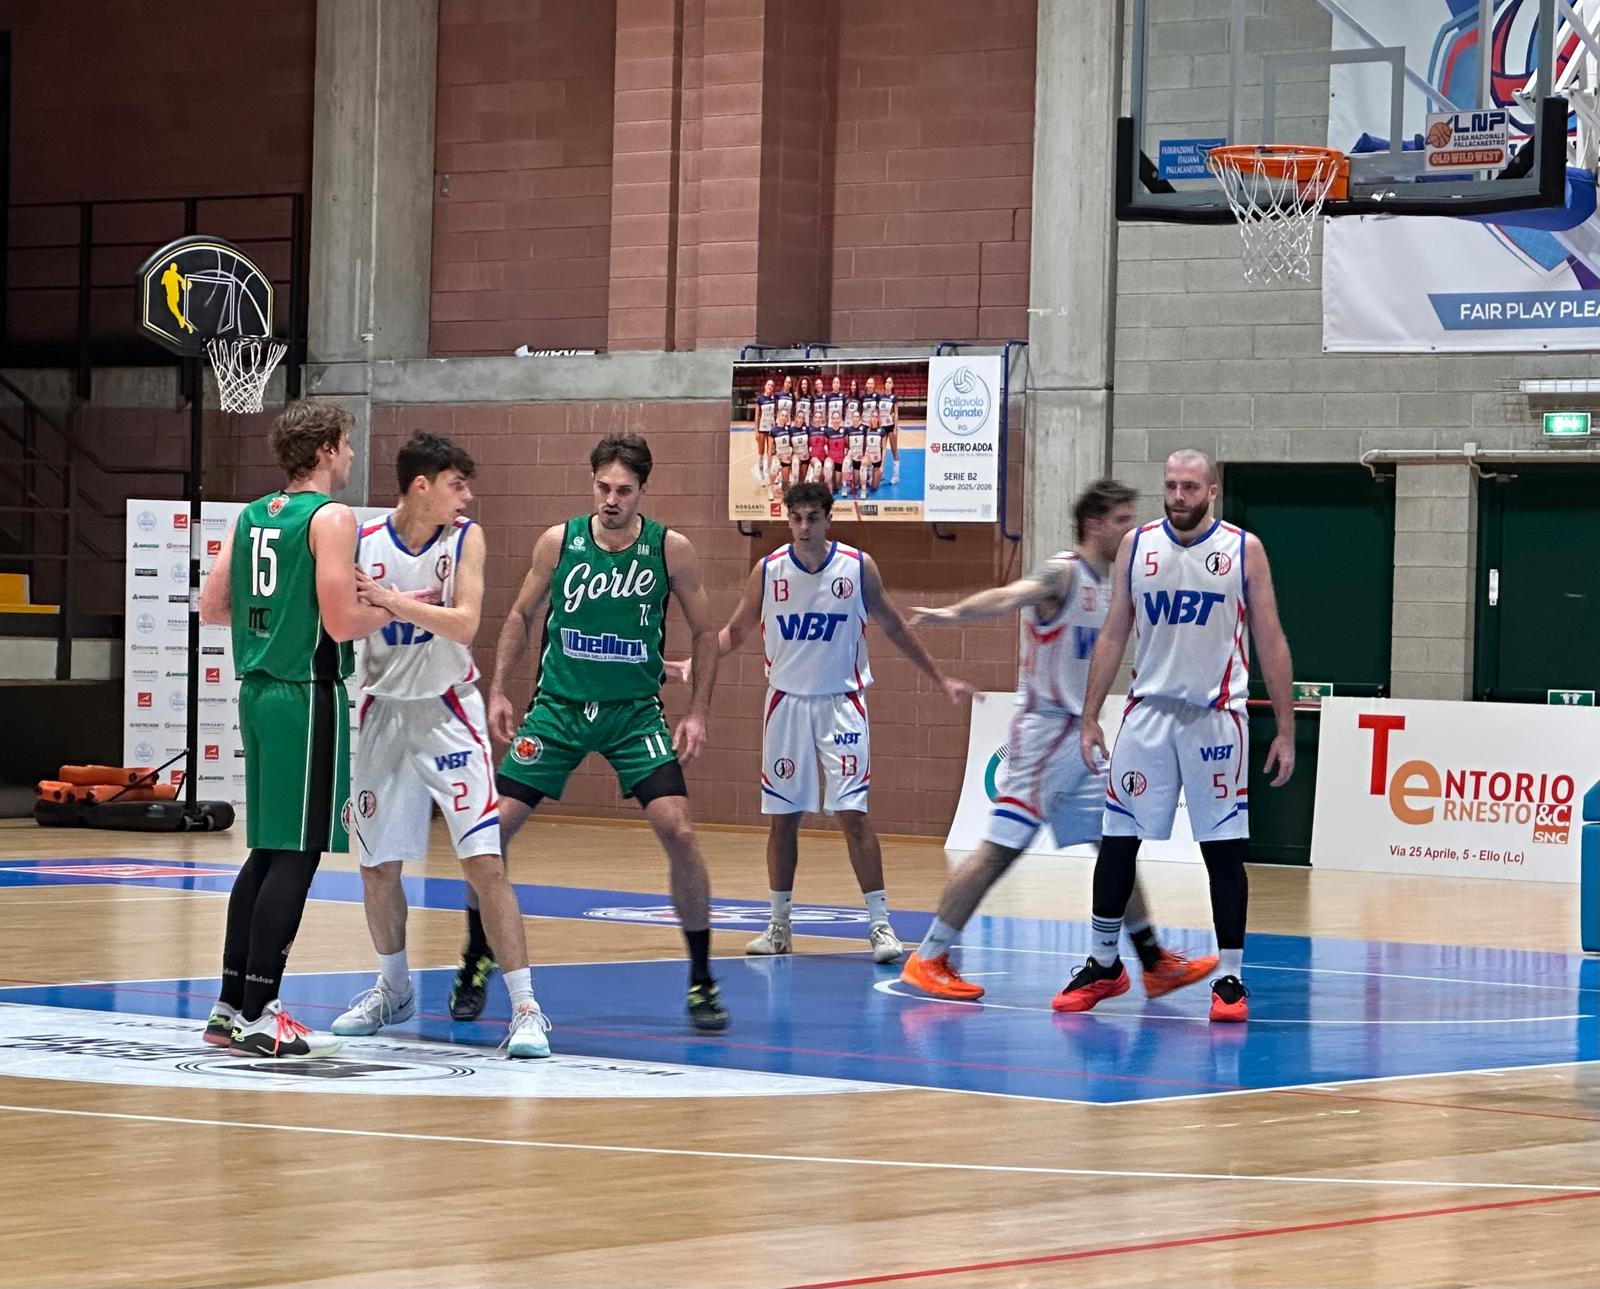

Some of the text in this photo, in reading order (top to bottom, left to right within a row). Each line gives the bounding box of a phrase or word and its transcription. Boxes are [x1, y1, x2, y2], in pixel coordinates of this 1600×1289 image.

[1453, 112, 1505, 133] LNP
[1453, 140, 1506, 148] PALLACANESTRO
[1470, 133, 1505, 141] NAZIONALE
[1161, 145, 1195, 155] FEDERAZIONE
[1431, 154, 1451, 164] OLD
[1451, 152, 1474, 163] WILD
[1475, 150, 1500, 161] WEST
[1177, 155, 1200, 164] ITALIANA
[1165, 165, 1205, 174] PALLACANESTRO
[1460, 303, 1503, 320] FAIR
[1506, 301, 1557, 318] PLAY
[944, 397, 984, 407] Pallavolo
[943, 407, 984, 420] Olginate
[941, 442, 993, 452] ELECTRO ADDA
[943, 472, 978, 481] SERIE B2
[929, 483, 993, 492] Stagione 2025/2026
[249, 526, 281, 597] 15
[1145, 551, 1158, 577] 5
[563, 559, 657, 613] Gorle
[773, 579, 789, 602] 13
[1143, 590, 1225, 626] WBT
[776, 612, 849, 642] WBT
[642, 731, 668, 759] 11
[833, 732, 861, 746] WBT
[434, 750, 473, 772] WBT
[1200, 744, 1233, 762] WBT
[841, 754, 857, 777] 13
[1213, 773, 1228, 799] 5
[451, 781, 471, 813] 2
[1534, 831, 1567, 844] SNC
[1390, 845, 1406, 857] Via
[1409, 846, 1422, 857] 25
[1424, 847, 1459, 860] Aprile,
[1462, 850, 1469, 860] 5
[1479, 851, 1501, 862] Ello
[1503, 852, 1525, 865] (Lc)
